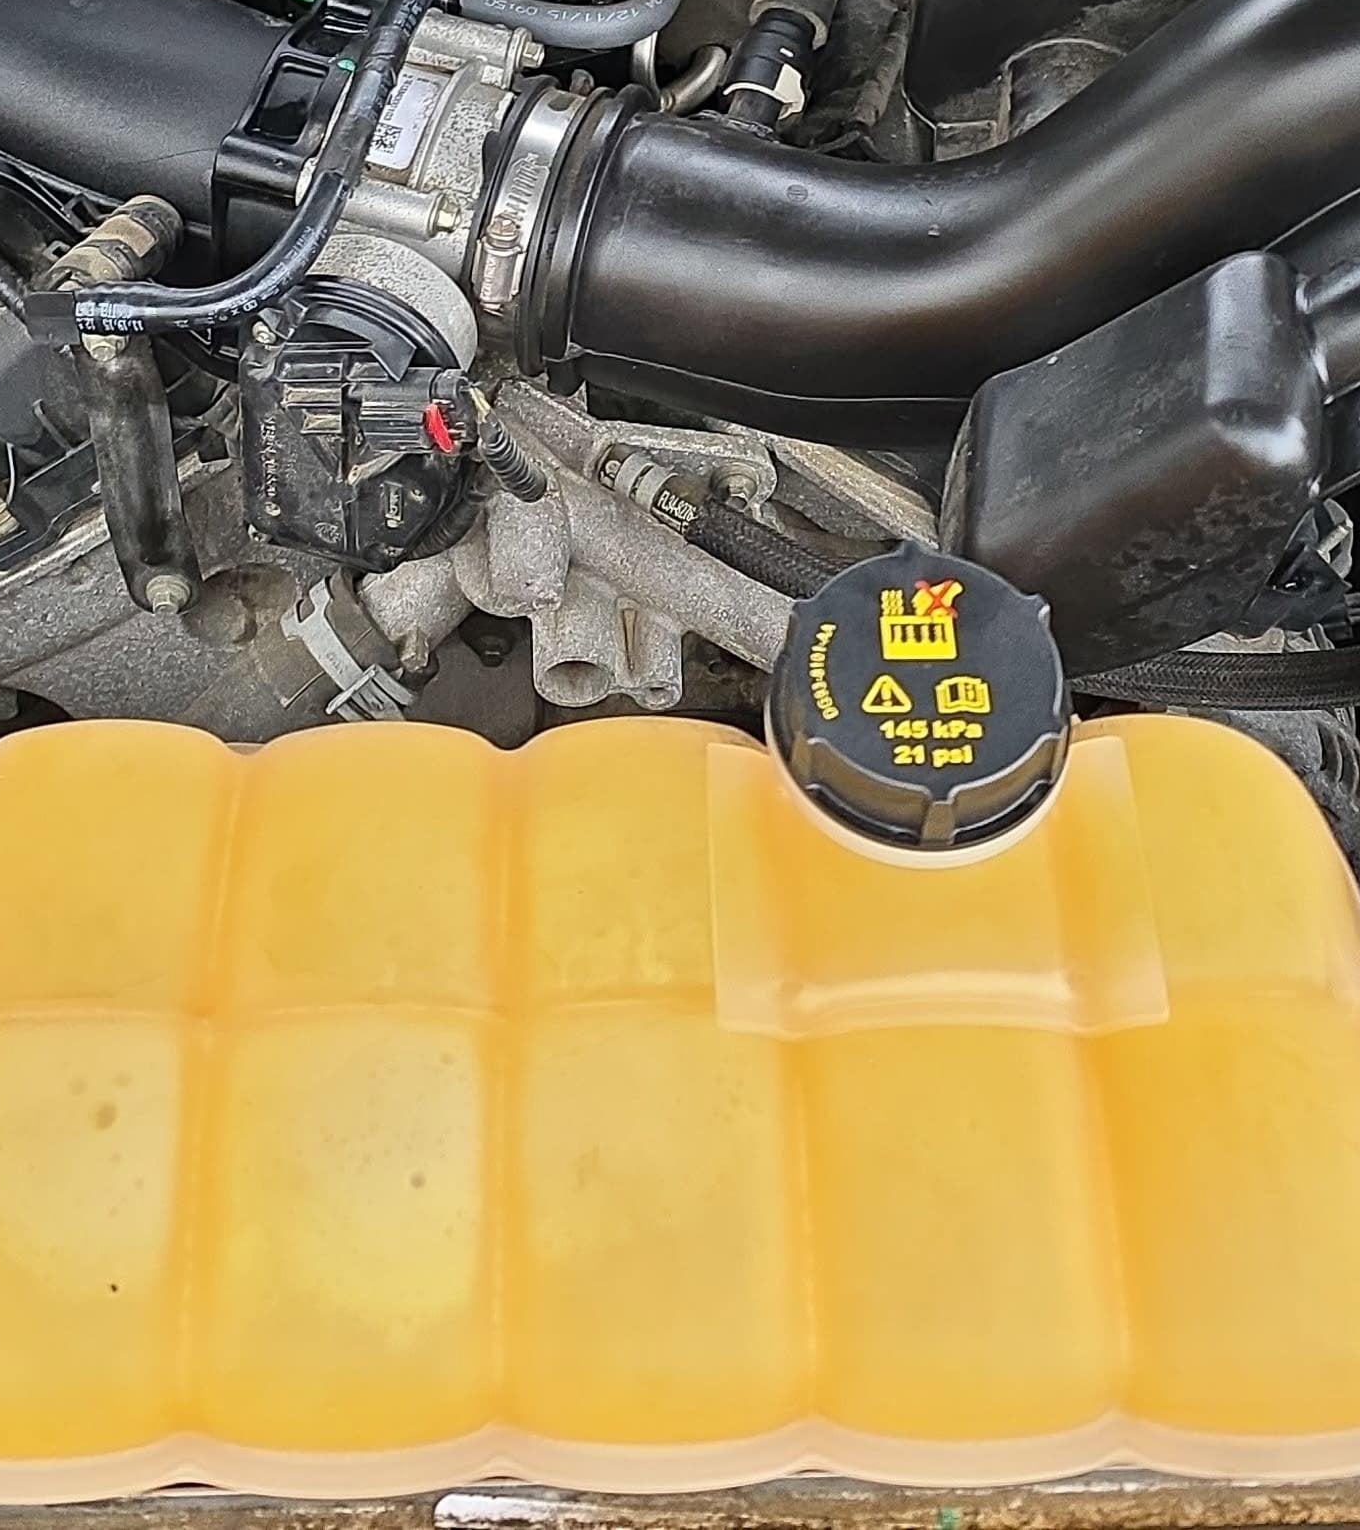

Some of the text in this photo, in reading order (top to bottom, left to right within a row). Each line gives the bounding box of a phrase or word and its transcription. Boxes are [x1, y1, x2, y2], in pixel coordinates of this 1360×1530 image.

[879, 719, 983, 739] 145 kPa
[893, 744, 974, 768] 21 psi
